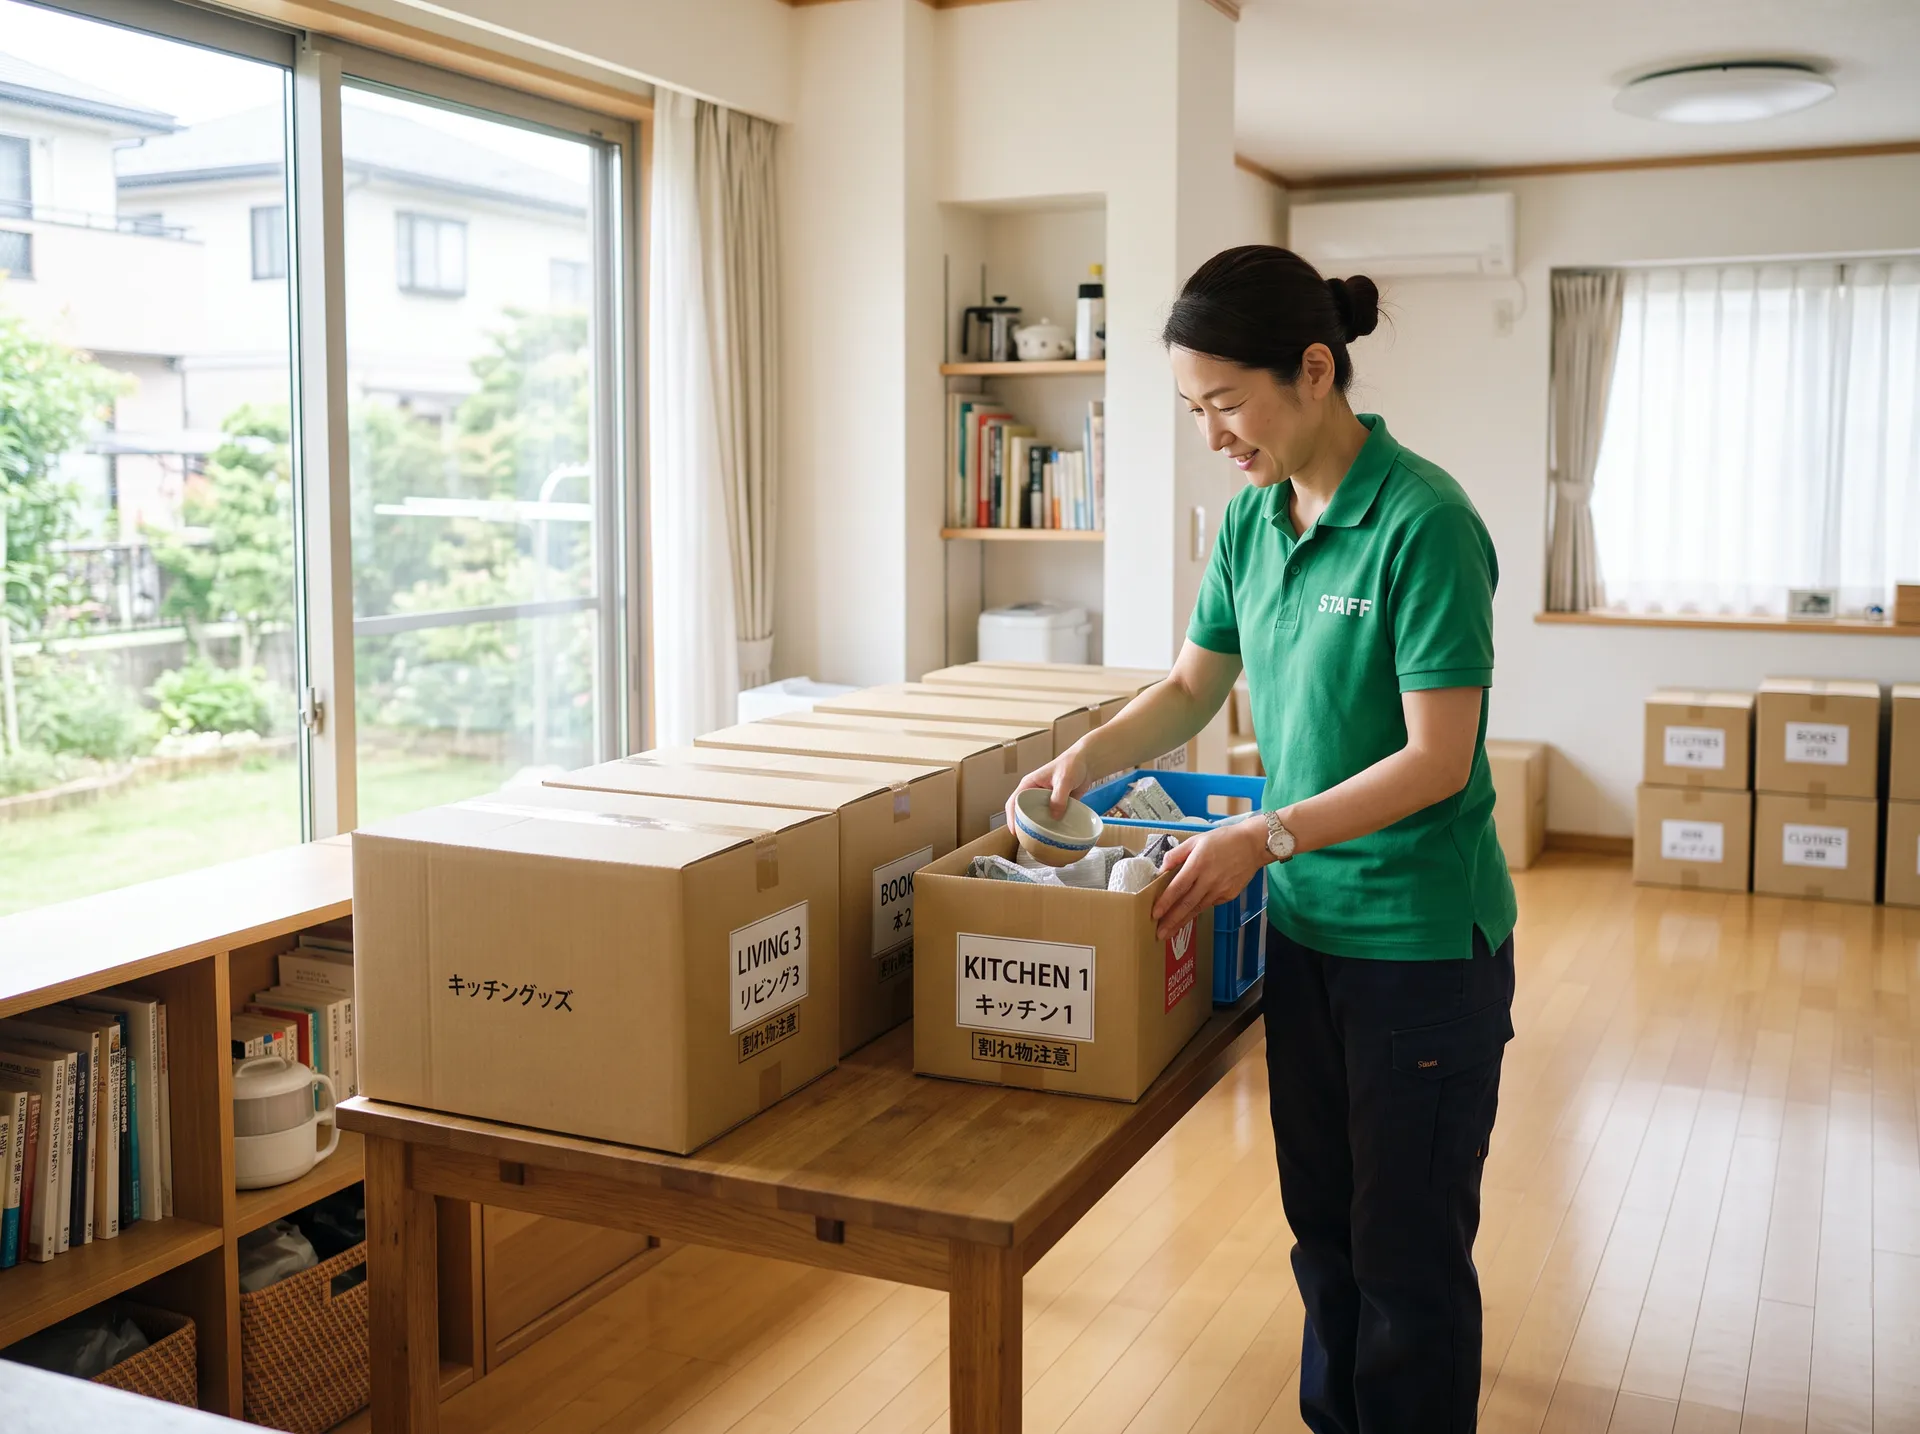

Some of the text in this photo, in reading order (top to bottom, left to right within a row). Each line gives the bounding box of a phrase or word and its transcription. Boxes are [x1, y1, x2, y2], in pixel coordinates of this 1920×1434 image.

[1318, 594, 1372, 617] STAFF
[738, 926, 801, 976] LIVING 3
[741, 965, 800, 1010] リビング3
[965, 955, 1088, 991] KITCHEN 1
[448, 974, 574, 1012] キッチングッズ
[975, 994, 1072, 1024] キッチン1
[742, 1012, 797, 1057] 割れ物注意
[978, 1037, 1070, 1067] 割れ物注意
